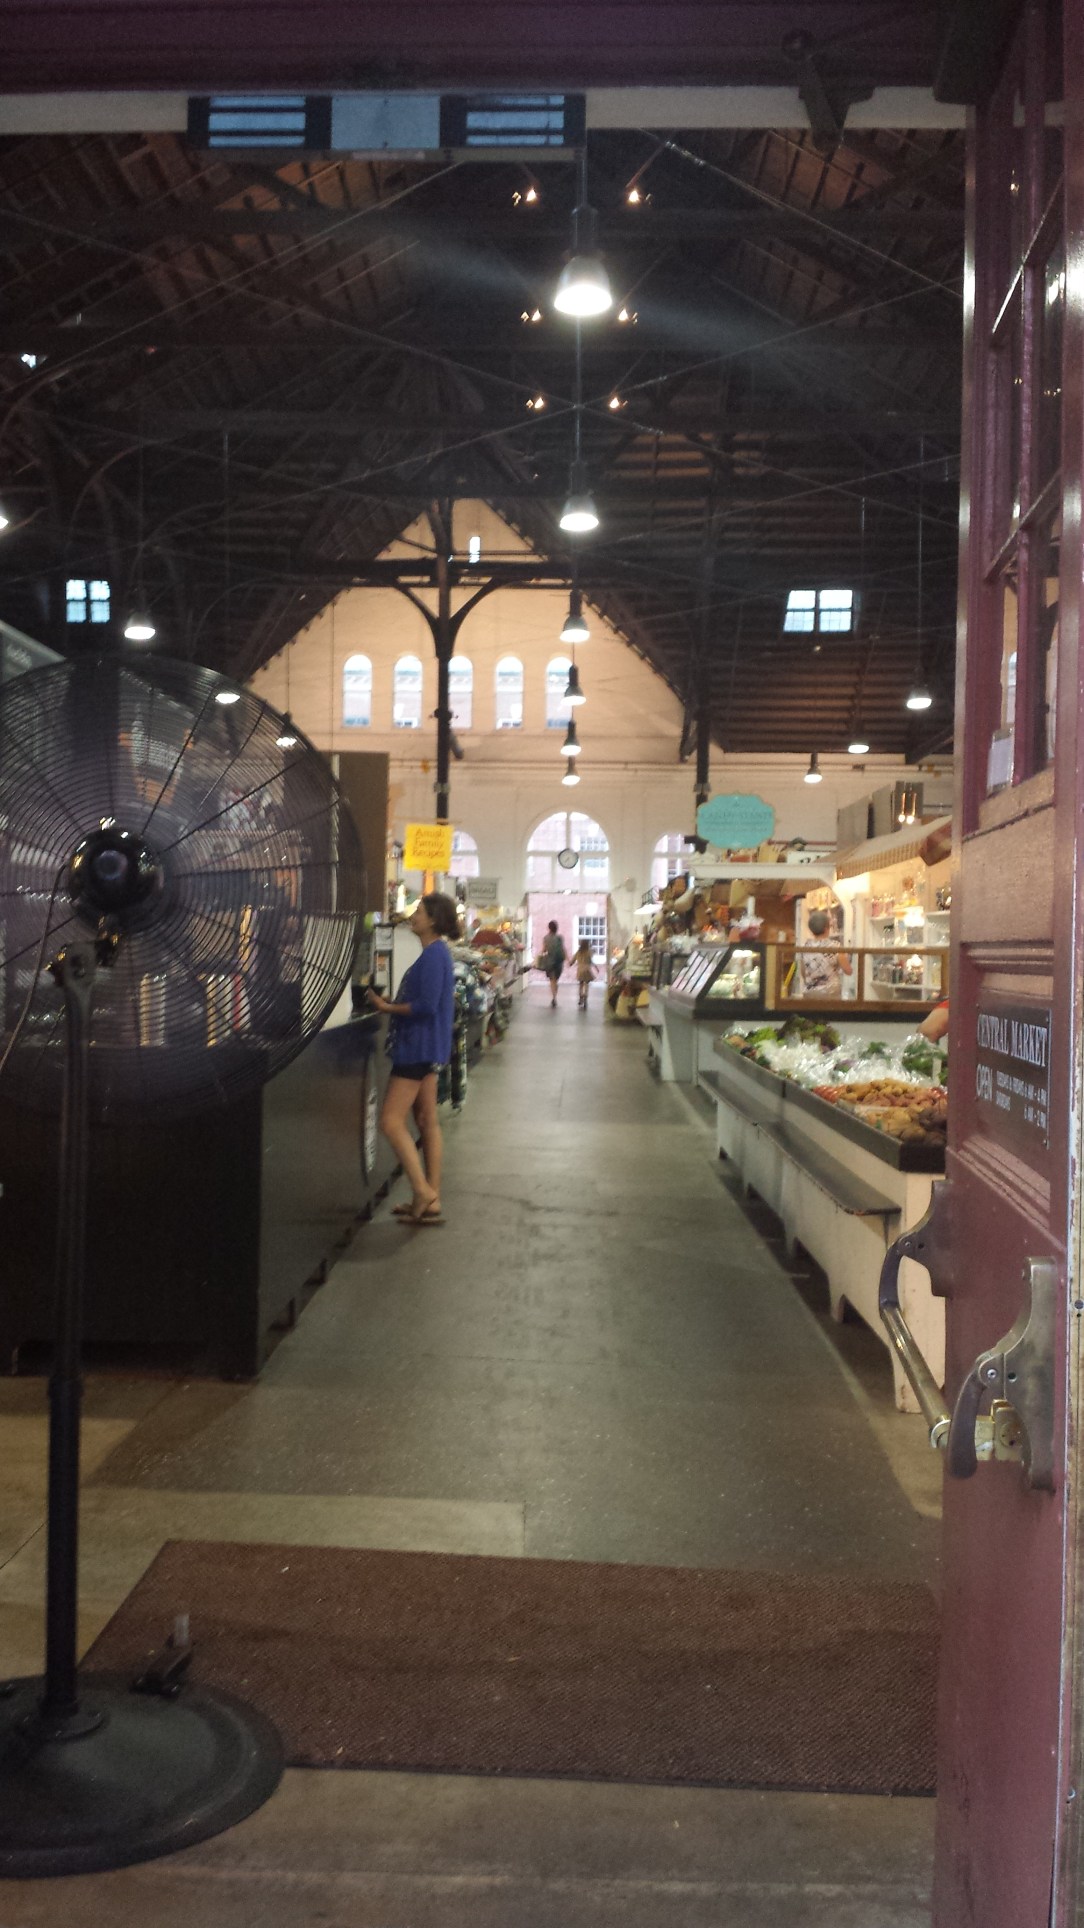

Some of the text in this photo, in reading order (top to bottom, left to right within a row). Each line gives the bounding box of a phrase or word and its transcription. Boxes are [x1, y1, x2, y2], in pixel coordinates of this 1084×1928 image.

[413, 848, 444, 858] Recipes
[415, 837, 444, 850] Family
[977, 1014, 1047, 1067] CENTRAL MARKET
[976, 1063, 993, 1101] OPEN
